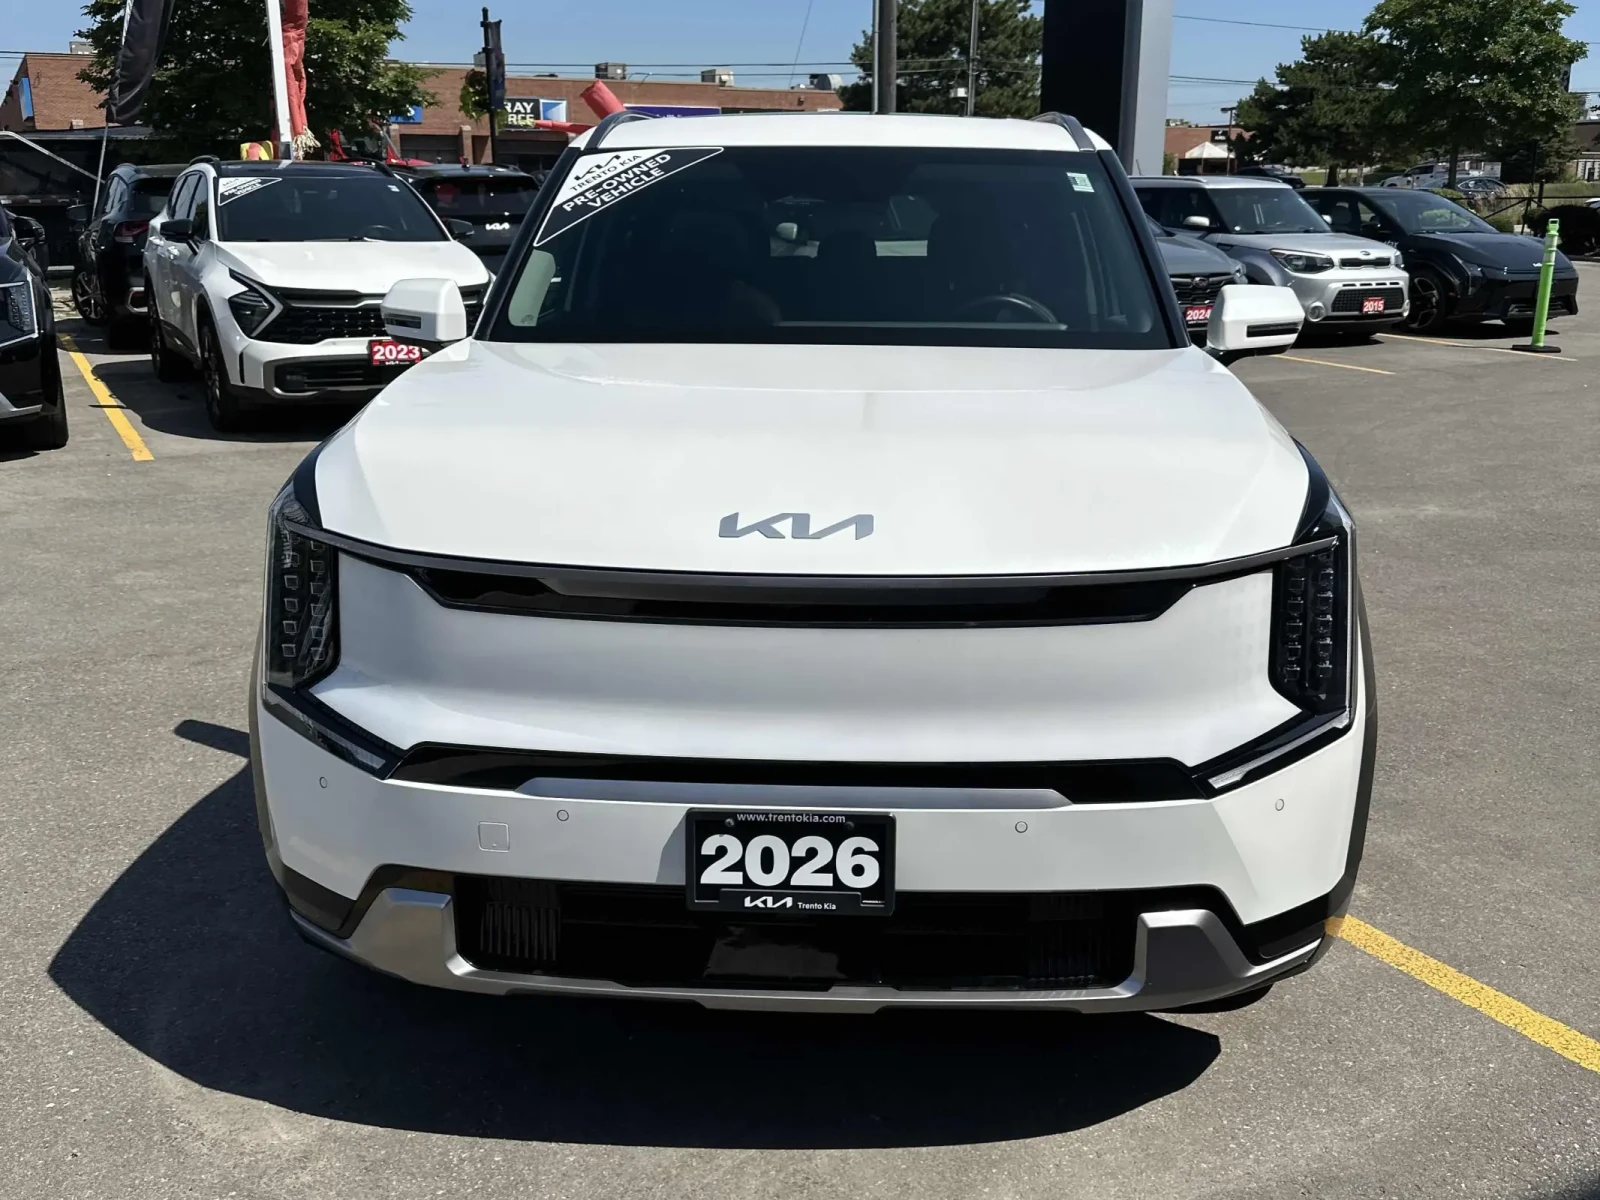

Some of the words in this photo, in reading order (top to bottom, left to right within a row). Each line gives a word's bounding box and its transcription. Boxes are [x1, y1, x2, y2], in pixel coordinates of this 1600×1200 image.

[562, 153, 672, 212] PRE-OWNED
[569, 166, 618, 192] TRENTO
[620, 154, 642, 167] KIA
[586, 167, 665, 208] VEHICLE
[1186, 309, 1212, 320] 2024
[1363, 300, 1385, 312] 2015
[373, 344, 420, 360] 2023
[718, 511, 874, 541] KIA
[736, 813, 846, 823] www.trentokia.com
[700, 833, 880, 889] 2026
[744, 895, 793, 908] KIA
[797, 902, 822, 910] Trento
[823, 902, 837, 910] Kia
